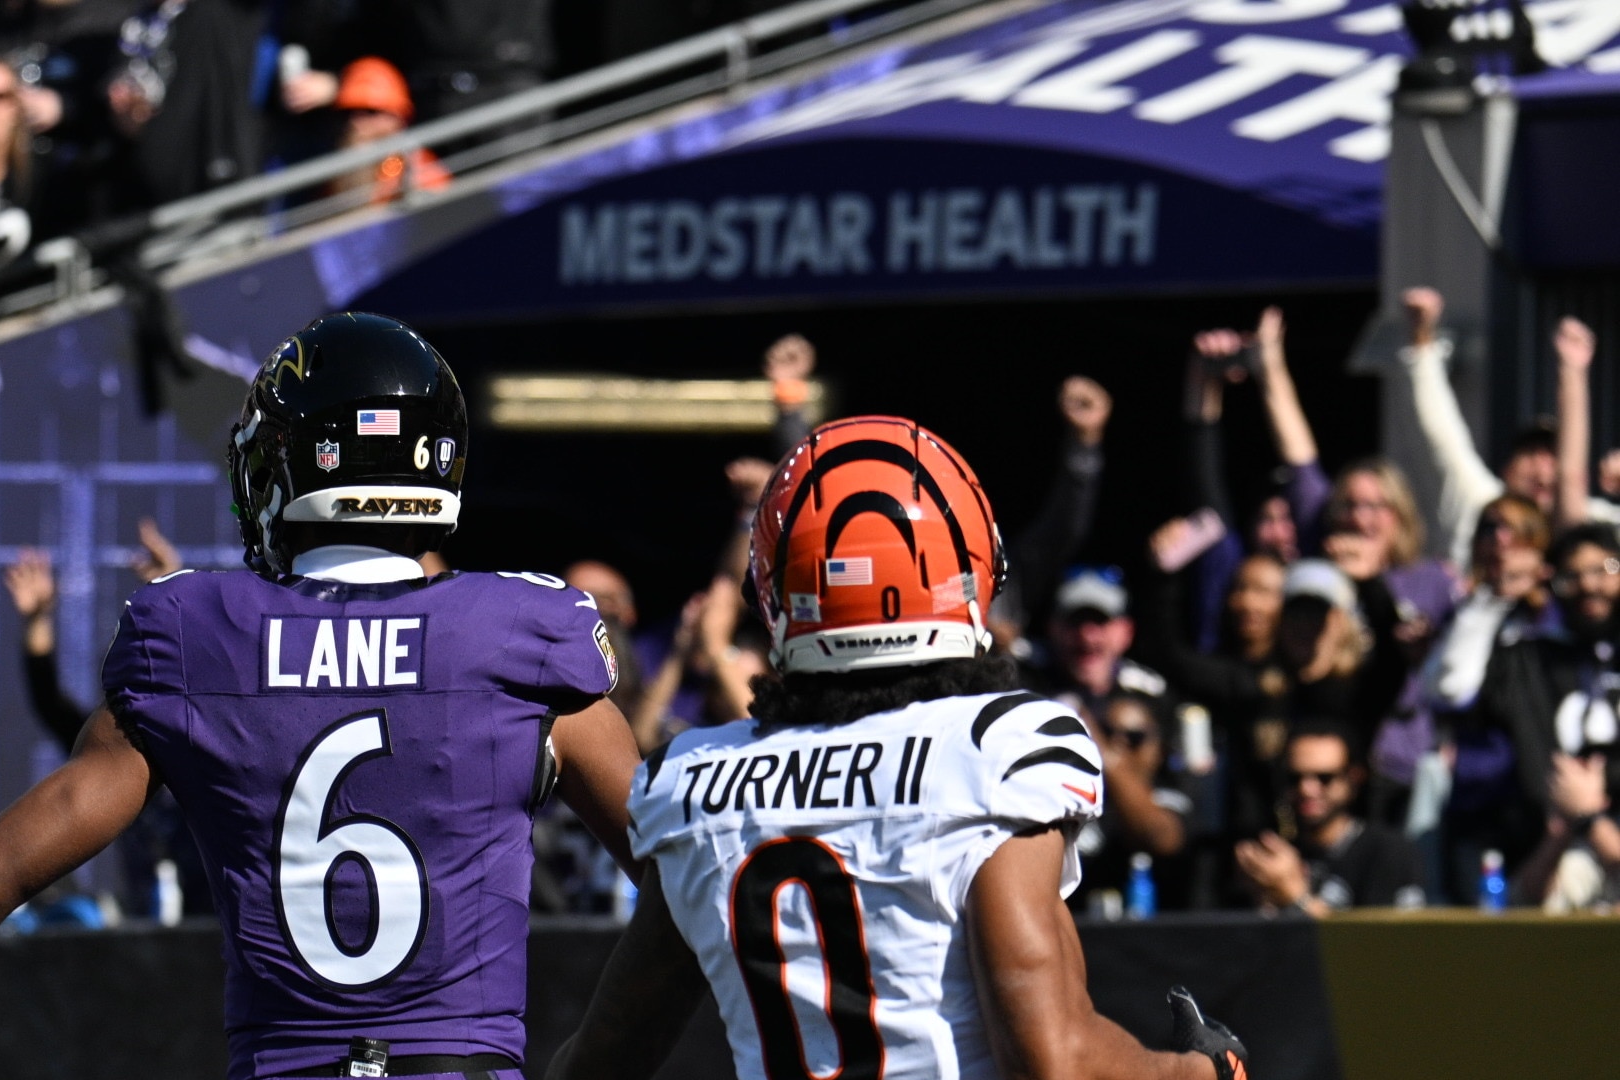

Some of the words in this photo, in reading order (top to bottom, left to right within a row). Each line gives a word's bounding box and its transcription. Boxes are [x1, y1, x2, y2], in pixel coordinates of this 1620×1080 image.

[559, 194, 875, 283] MEDSTAR
[887, 183, 1159, 271] HEALTH
[319, 454, 338, 467] NFL
[413, 435, 430, 470] 6
[332, 497, 443, 519] RAVENS
[881, 586, 900, 621] 0
[268, 618, 421, 687] LANE
[834, 634, 917, 648] BENGALS
[683, 742, 883, 825] TURNER
[894, 736, 933, 805] II
[273, 707, 430, 993] 6
